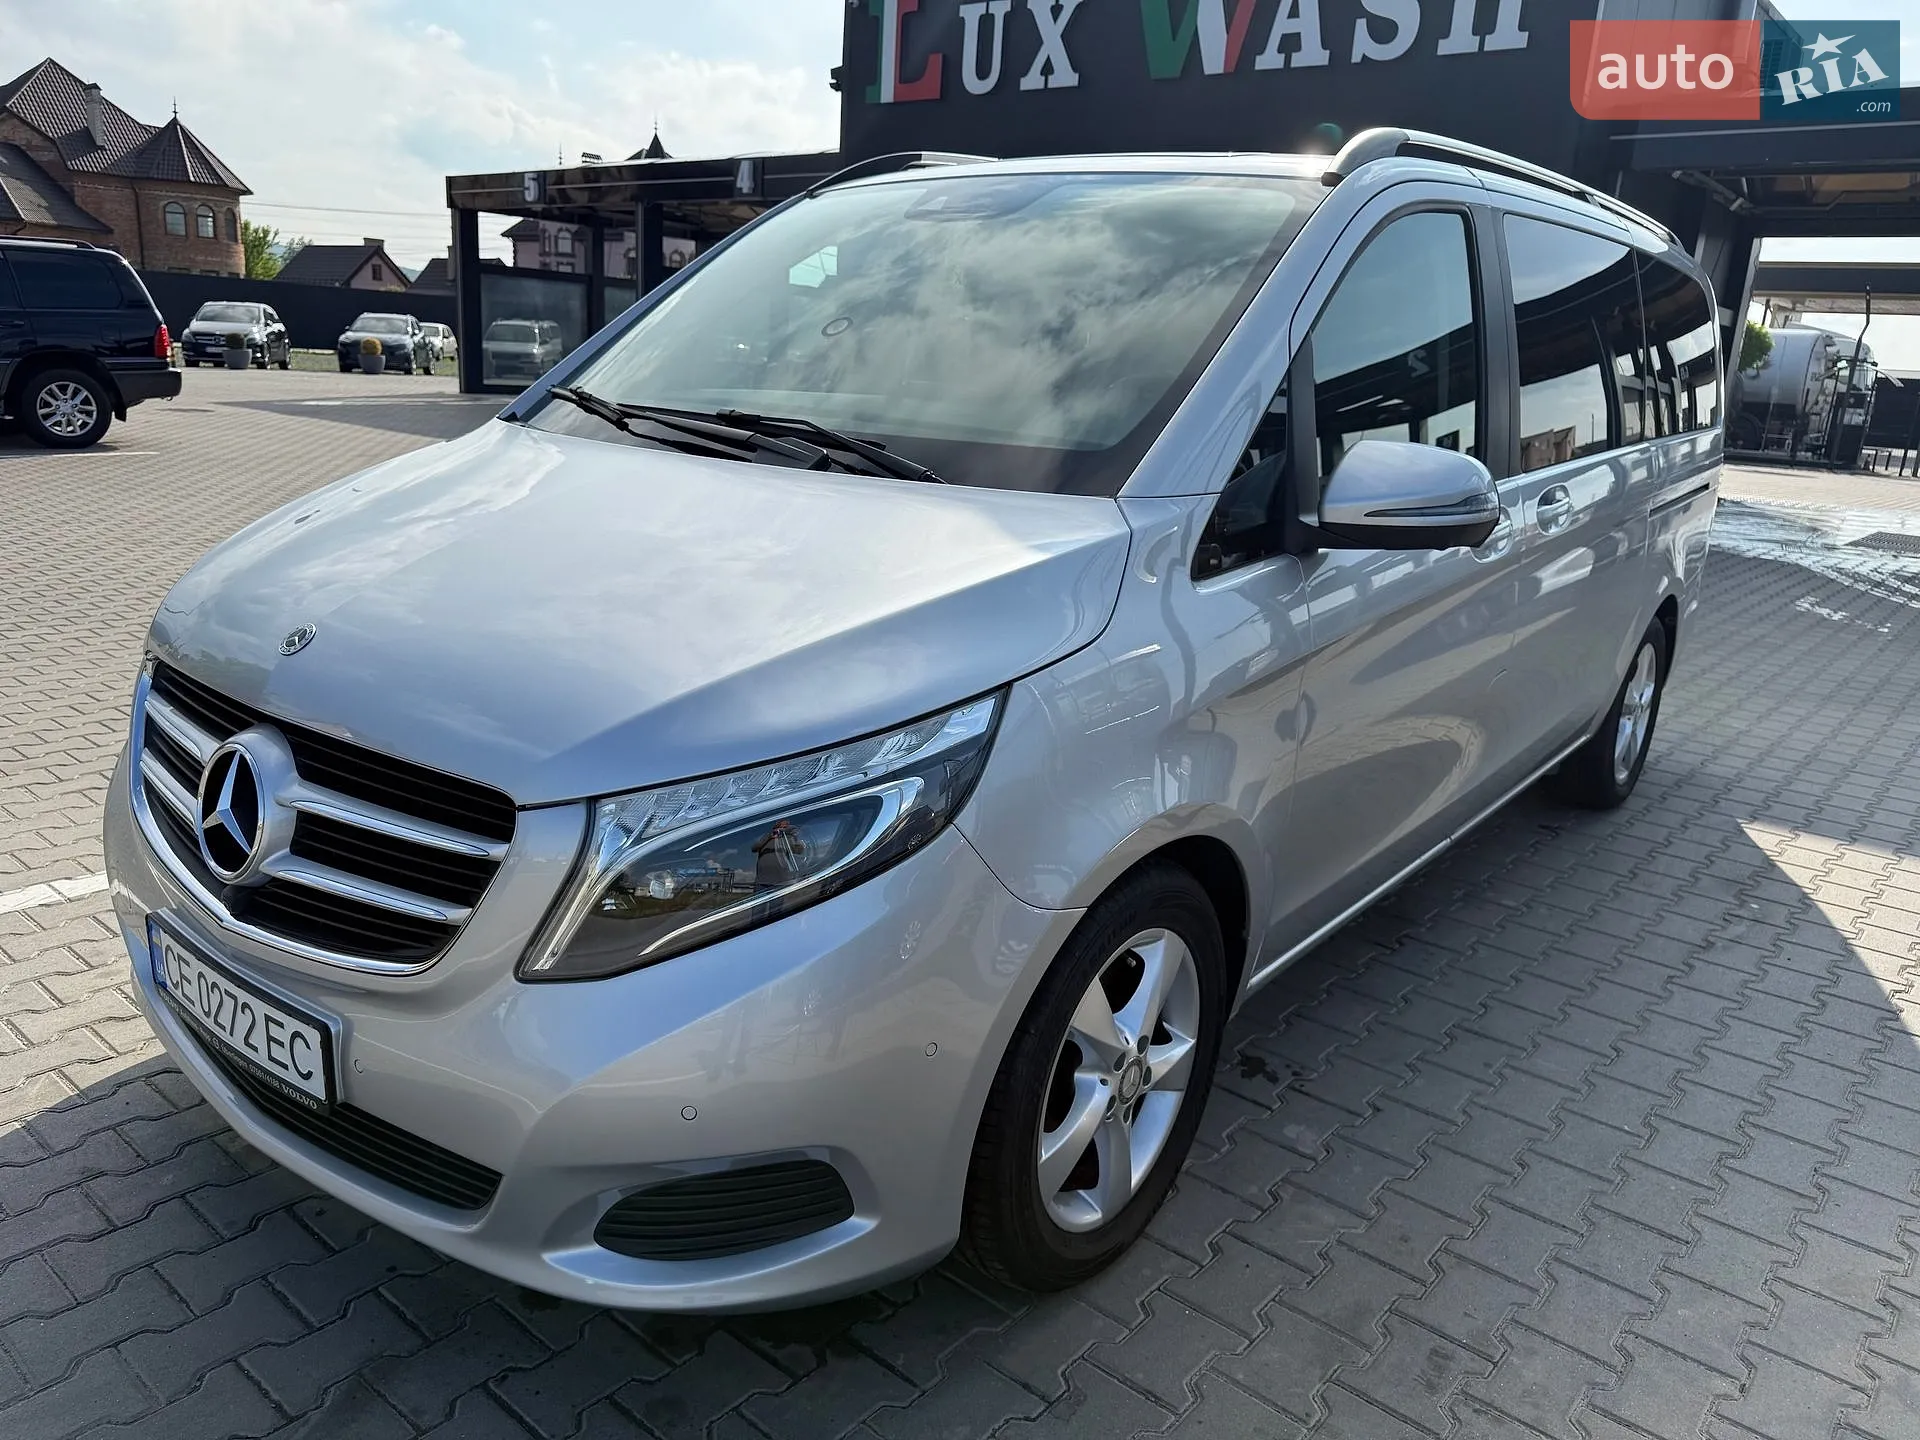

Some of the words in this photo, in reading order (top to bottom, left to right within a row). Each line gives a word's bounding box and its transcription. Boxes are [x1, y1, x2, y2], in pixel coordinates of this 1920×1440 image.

[865, 0, 1083, 103] LUX
[524, 172, 539, 202] 5
[736, 160, 755, 194] 4
[165, 944, 195, 1008] CE
[197, 971, 259, 1054] 0272
[264, 1012, 314, 1081] EC
[280, 1082, 318, 1110] VOLVO
